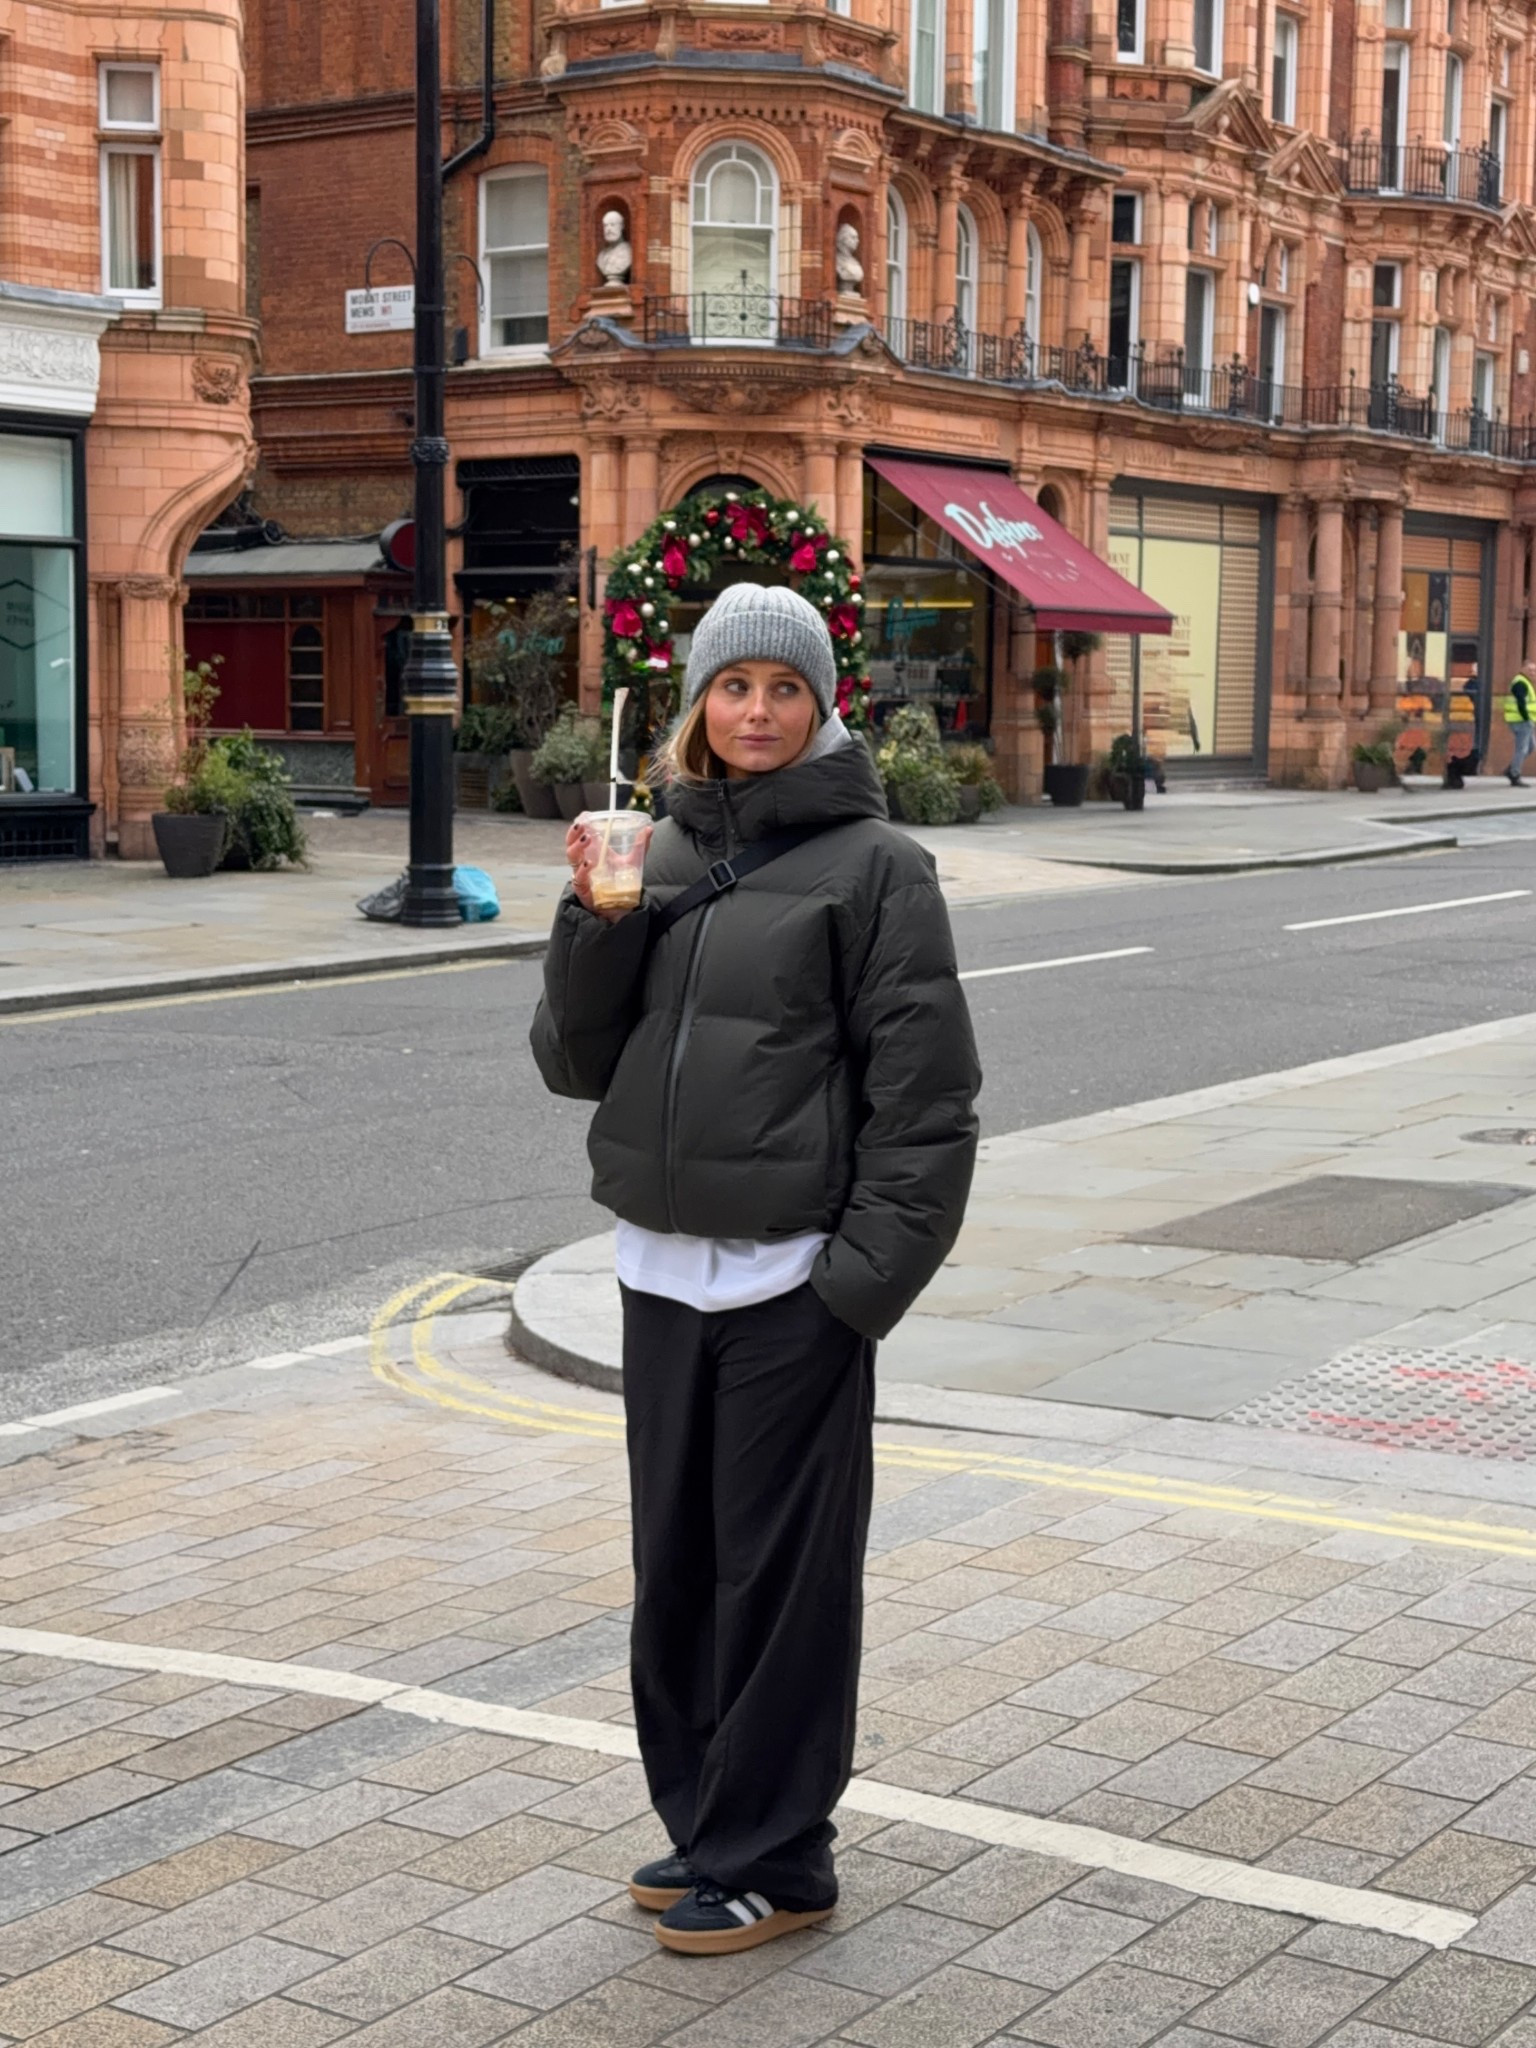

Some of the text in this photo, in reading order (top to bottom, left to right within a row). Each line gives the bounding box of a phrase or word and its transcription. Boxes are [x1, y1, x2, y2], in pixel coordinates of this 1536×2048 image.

[350, 290, 411, 305] MOUNT STREET
[351, 306, 375, 318] MEWS
